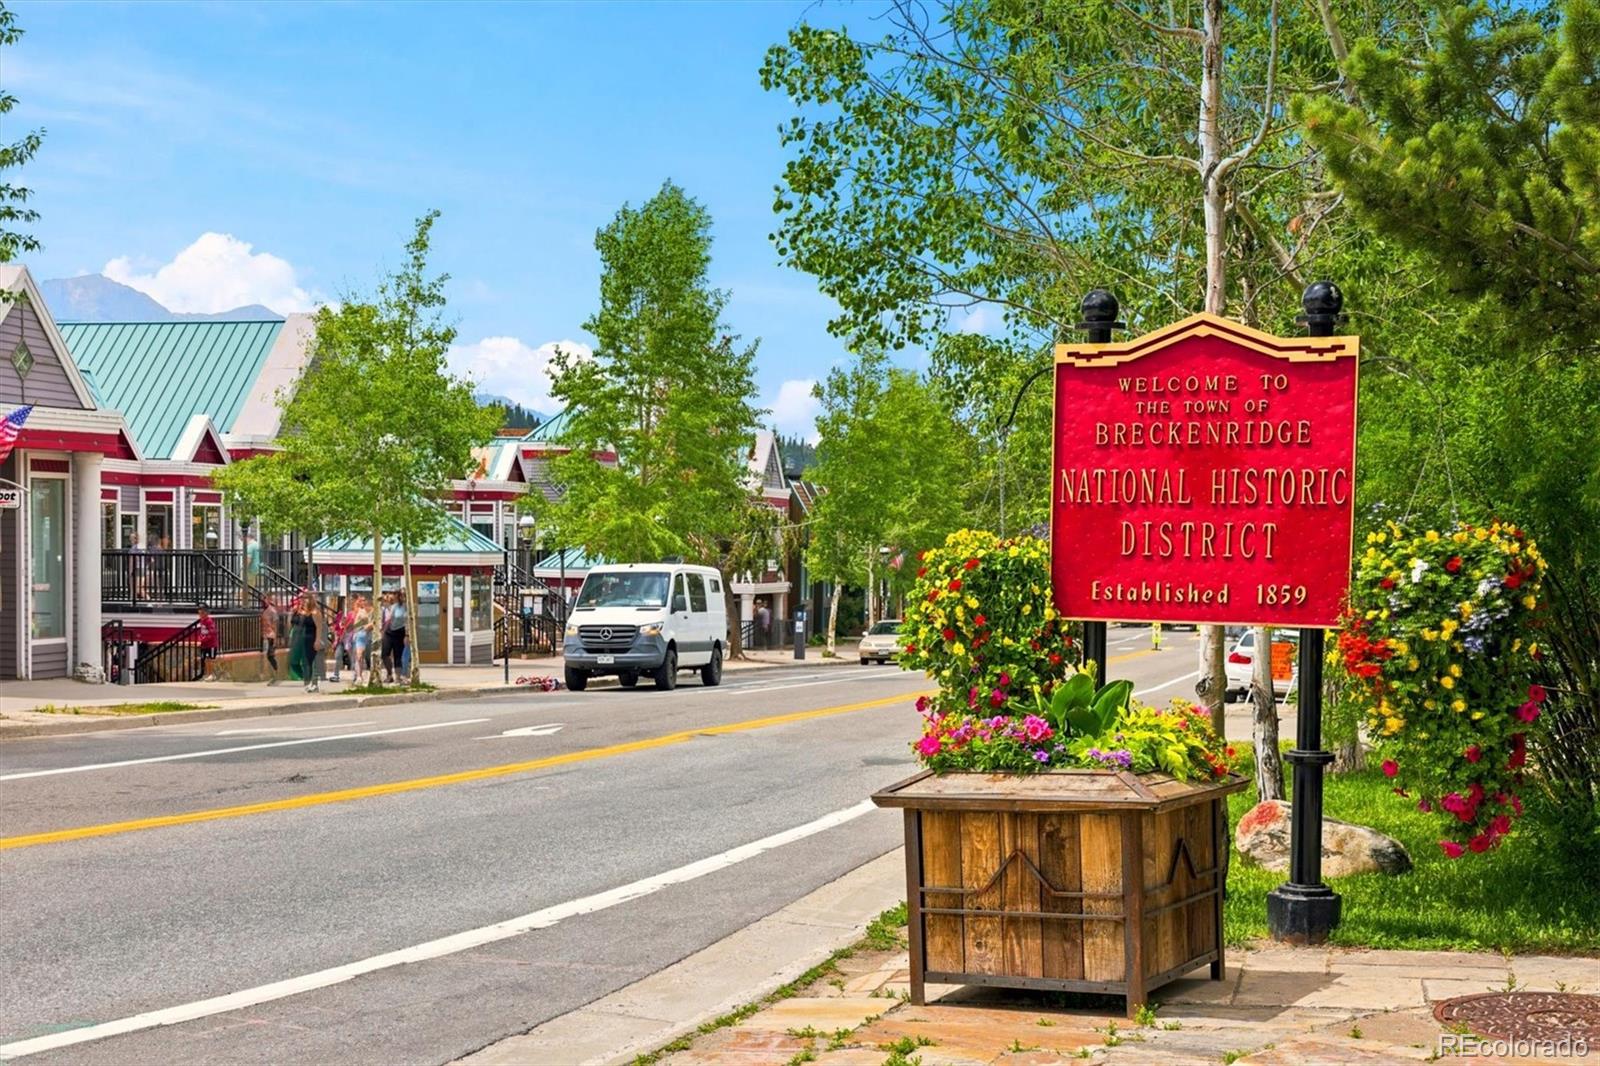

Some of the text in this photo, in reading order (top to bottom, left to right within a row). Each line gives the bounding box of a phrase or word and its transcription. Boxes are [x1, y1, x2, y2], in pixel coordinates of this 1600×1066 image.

[1119, 374, 1289, 392] WELCOME TO
[1136, 400, 1269, 414] THE TOWN OF
[1095, 420, 1312, 445] BRECKENRIDGE
[1060, 468, 1346, 504] NATIONAL HISTORIC
[1121, 521, 1277, 559] DISTRICT
[1092, 581, 1307, 604] Established 1859
